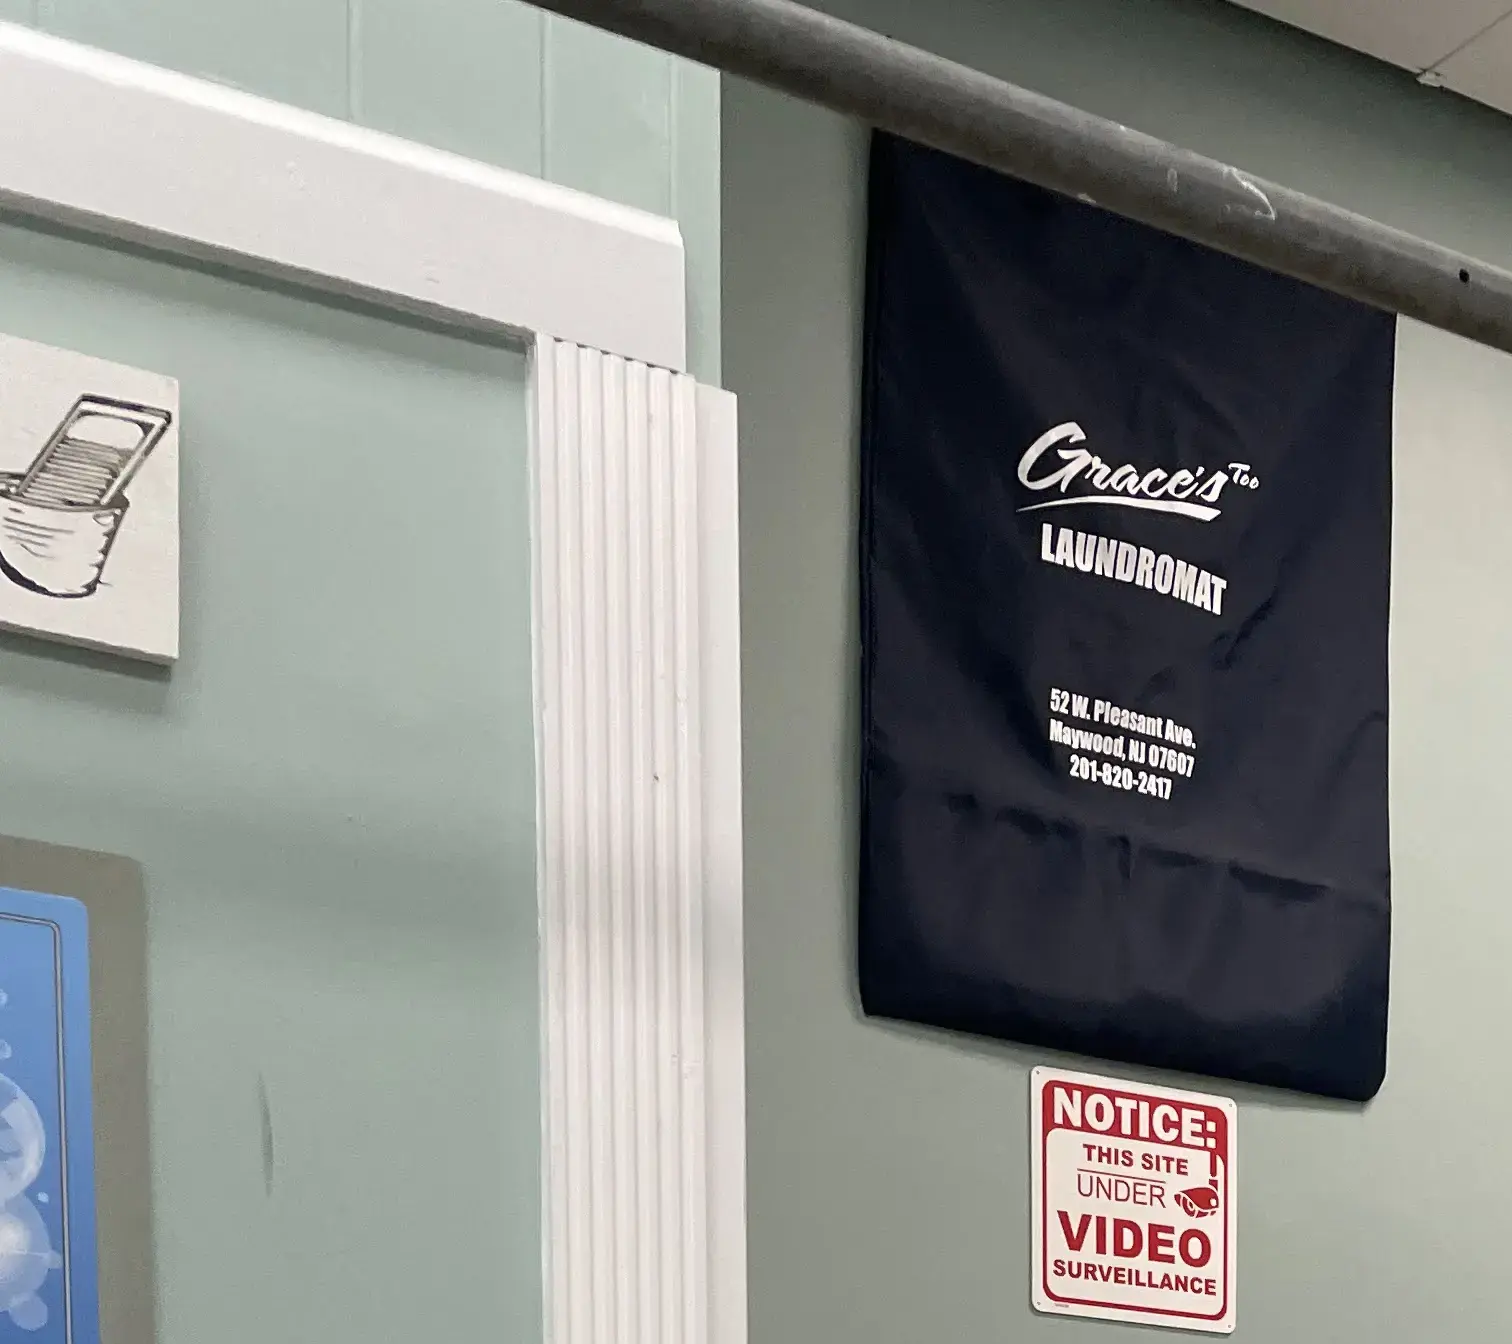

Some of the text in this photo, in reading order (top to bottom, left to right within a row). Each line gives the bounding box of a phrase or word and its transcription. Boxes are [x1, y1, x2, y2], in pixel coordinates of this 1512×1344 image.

[1017, 421, 1259, 502] Grace's Too
[1041, 523, 1227, 615] LAUNDROMAT
[1050, 687, 1196, 749] 52 W. Pleasant Ave.
[1049, 718, 1195, 778] Maywood, NJ 07607
[1069, 754, 1172, 800] 201-820-2417
[1053, 1086, 1217, 1148] NOTICE:
[1082, 1143, 1189, 1176] THIS SITE
[1077, 1174, 1166, 1208] UNDER
[1057, 1210, 1211, 1267] VIDEO
[1053, 1259, 1217, 1296] SURVEILLANCE
